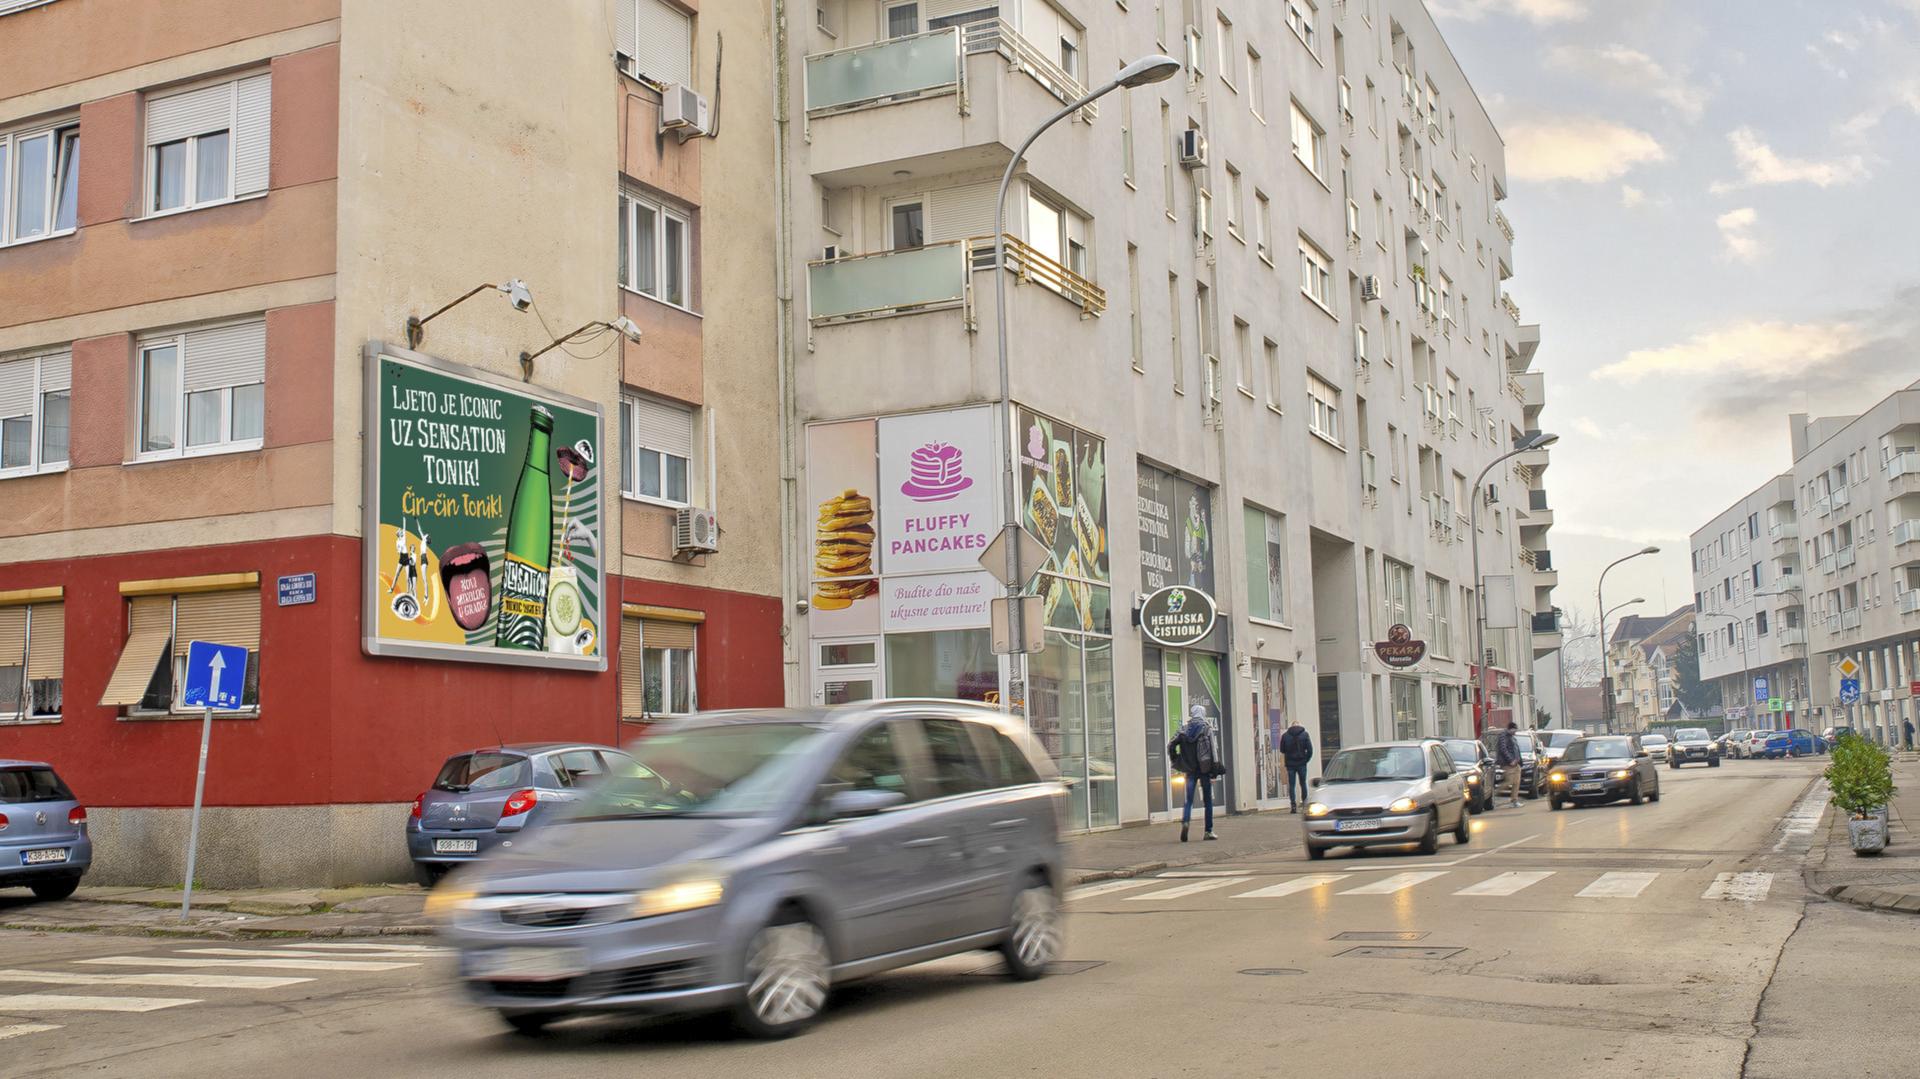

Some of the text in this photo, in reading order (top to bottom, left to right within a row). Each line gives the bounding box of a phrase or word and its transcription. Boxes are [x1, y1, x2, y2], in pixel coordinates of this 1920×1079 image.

[390, 418, 414, 447] UZ
[905, 513, 970, 533] FLUFFY
[891, 533, 987, 555] PANCAKES
[894, 582, 981, 600] Budite dio naše
[890, 601, 987, 620] ukusne avanture!
[1151, 613, 1205, 626] HEMIJSKA
[1153, 625, 1203, 637] ČISTIONA
[1380, 646, 1421, 656] PEKARA
